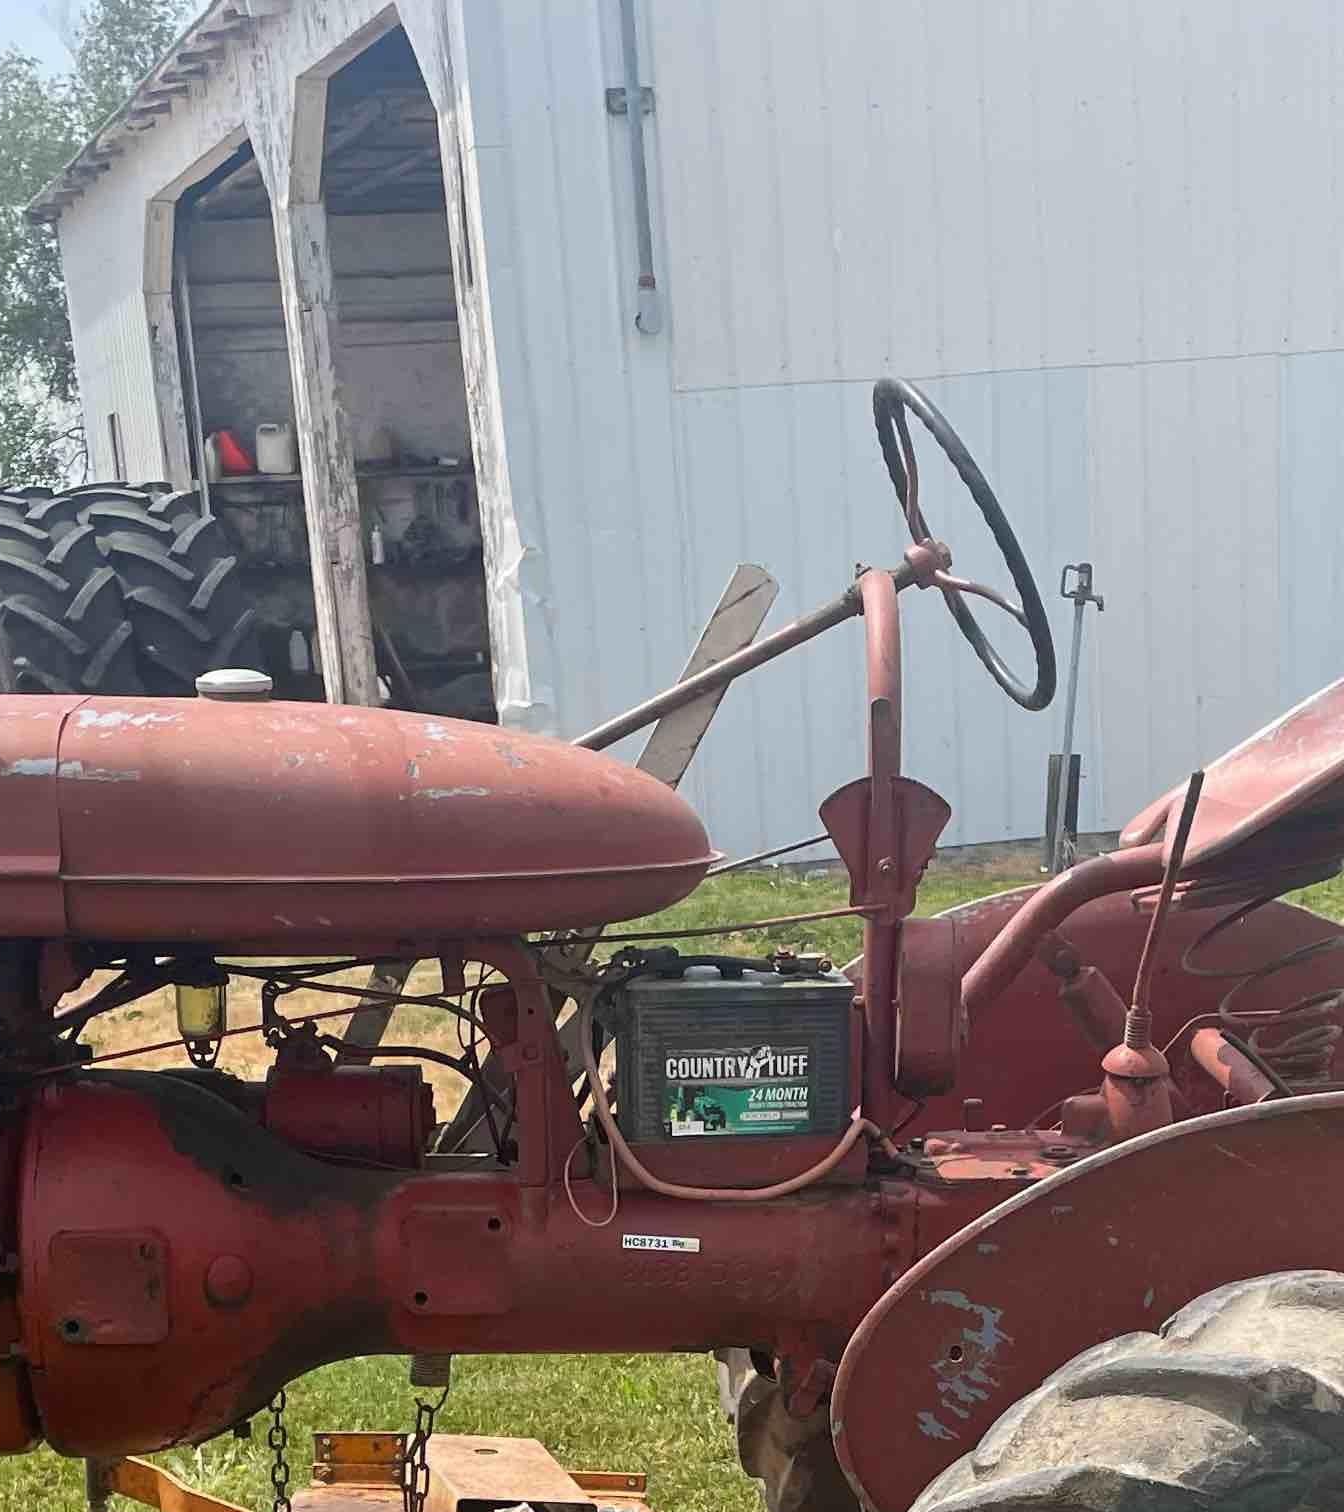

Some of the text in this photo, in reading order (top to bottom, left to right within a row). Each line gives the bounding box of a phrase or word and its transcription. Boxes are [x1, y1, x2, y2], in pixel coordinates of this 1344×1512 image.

[665, 1055, 808, 1079] COUNTRY TUFF
[747, 1087, 808, 1102] 24 MONTH
[624, 1237, 668, 1249] HC8731
